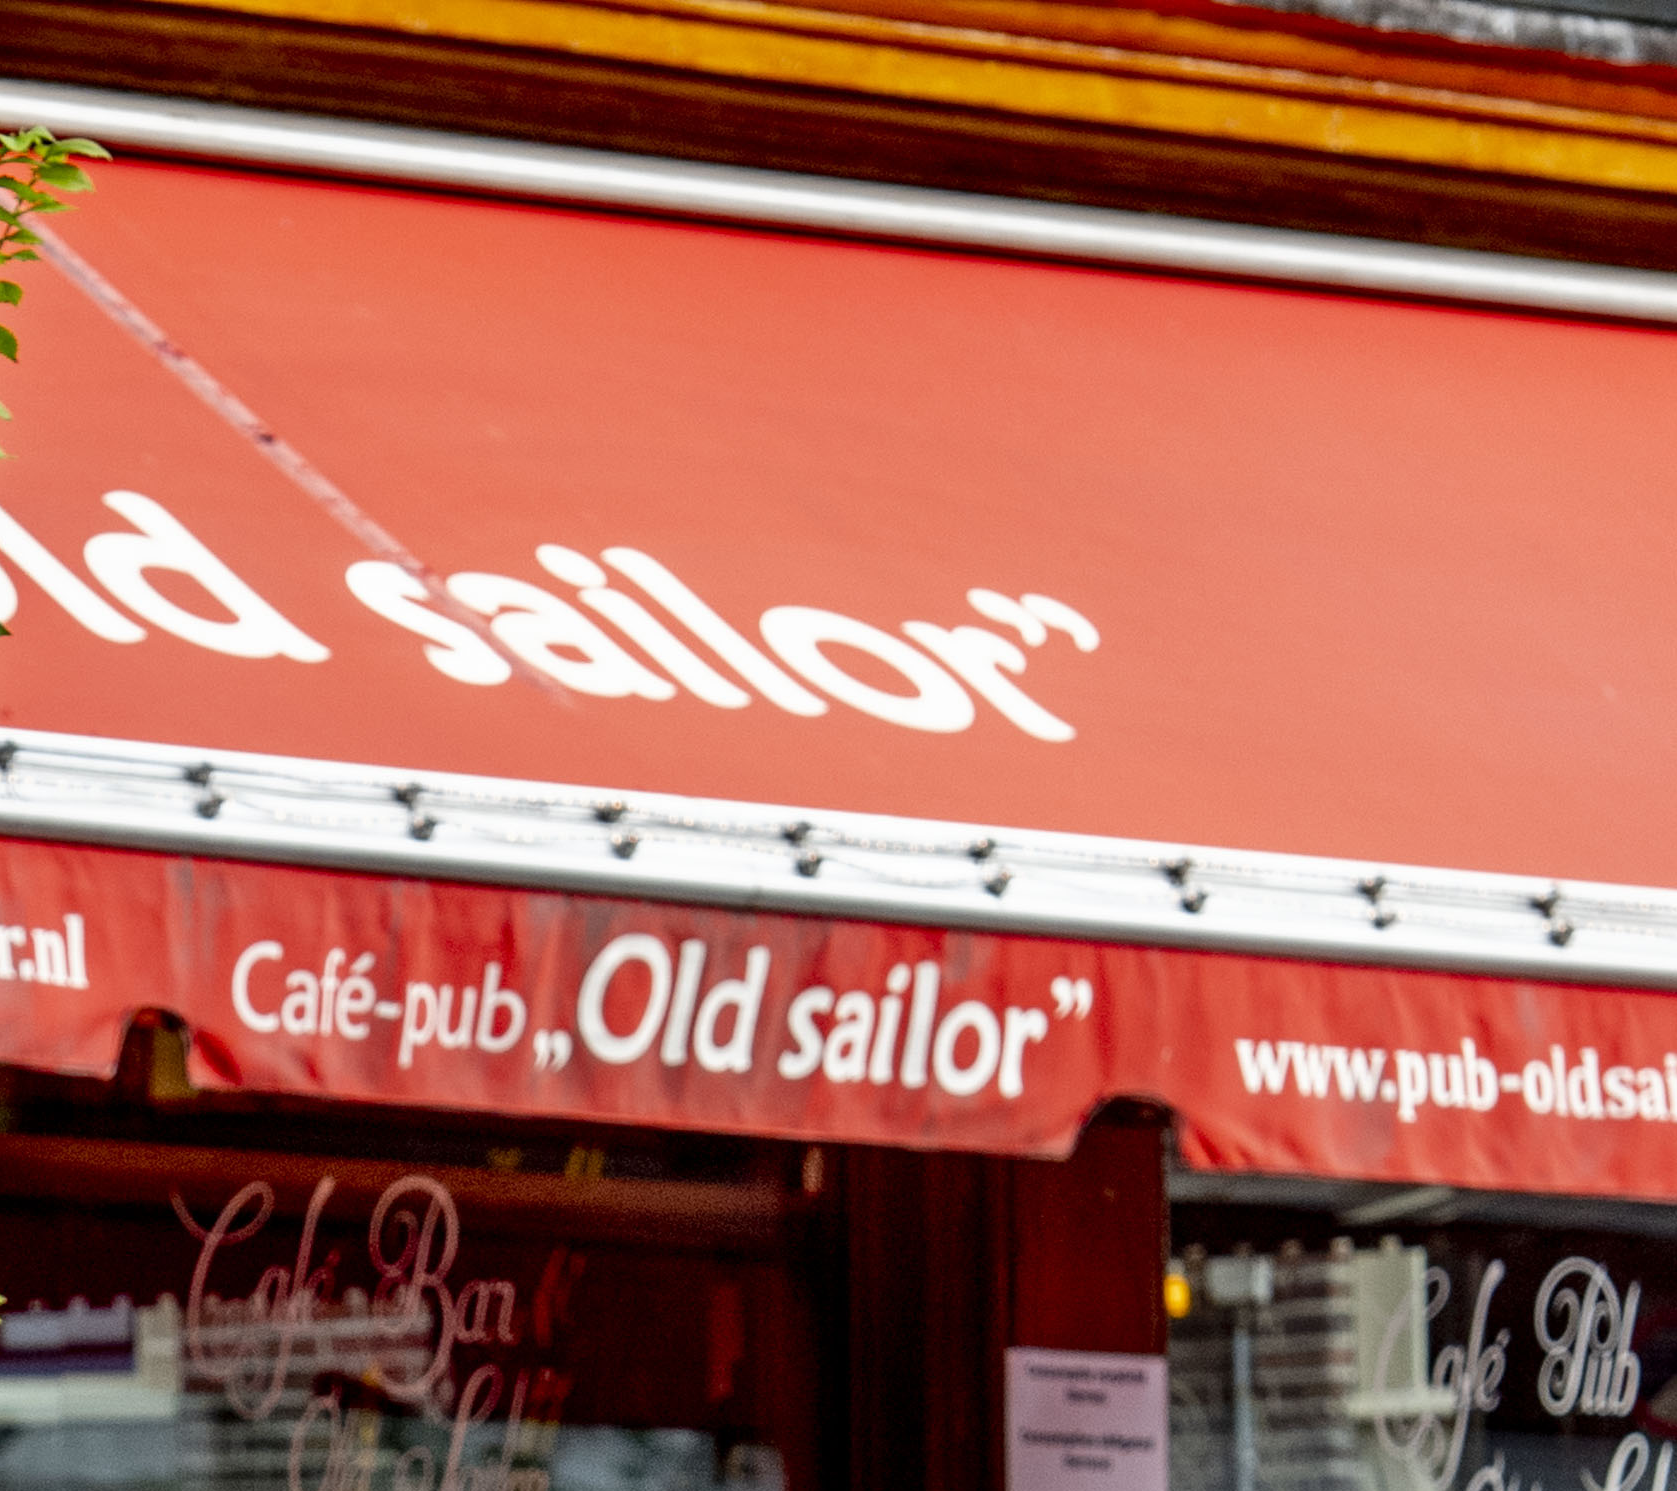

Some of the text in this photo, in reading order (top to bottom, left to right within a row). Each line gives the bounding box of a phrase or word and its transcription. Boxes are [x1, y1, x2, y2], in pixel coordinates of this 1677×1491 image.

[231, 939, 528, 1070] Café-pub
[777, 961, 1094, 1099] sailor”
[1533, 1255, 1641, 1417] Pub
